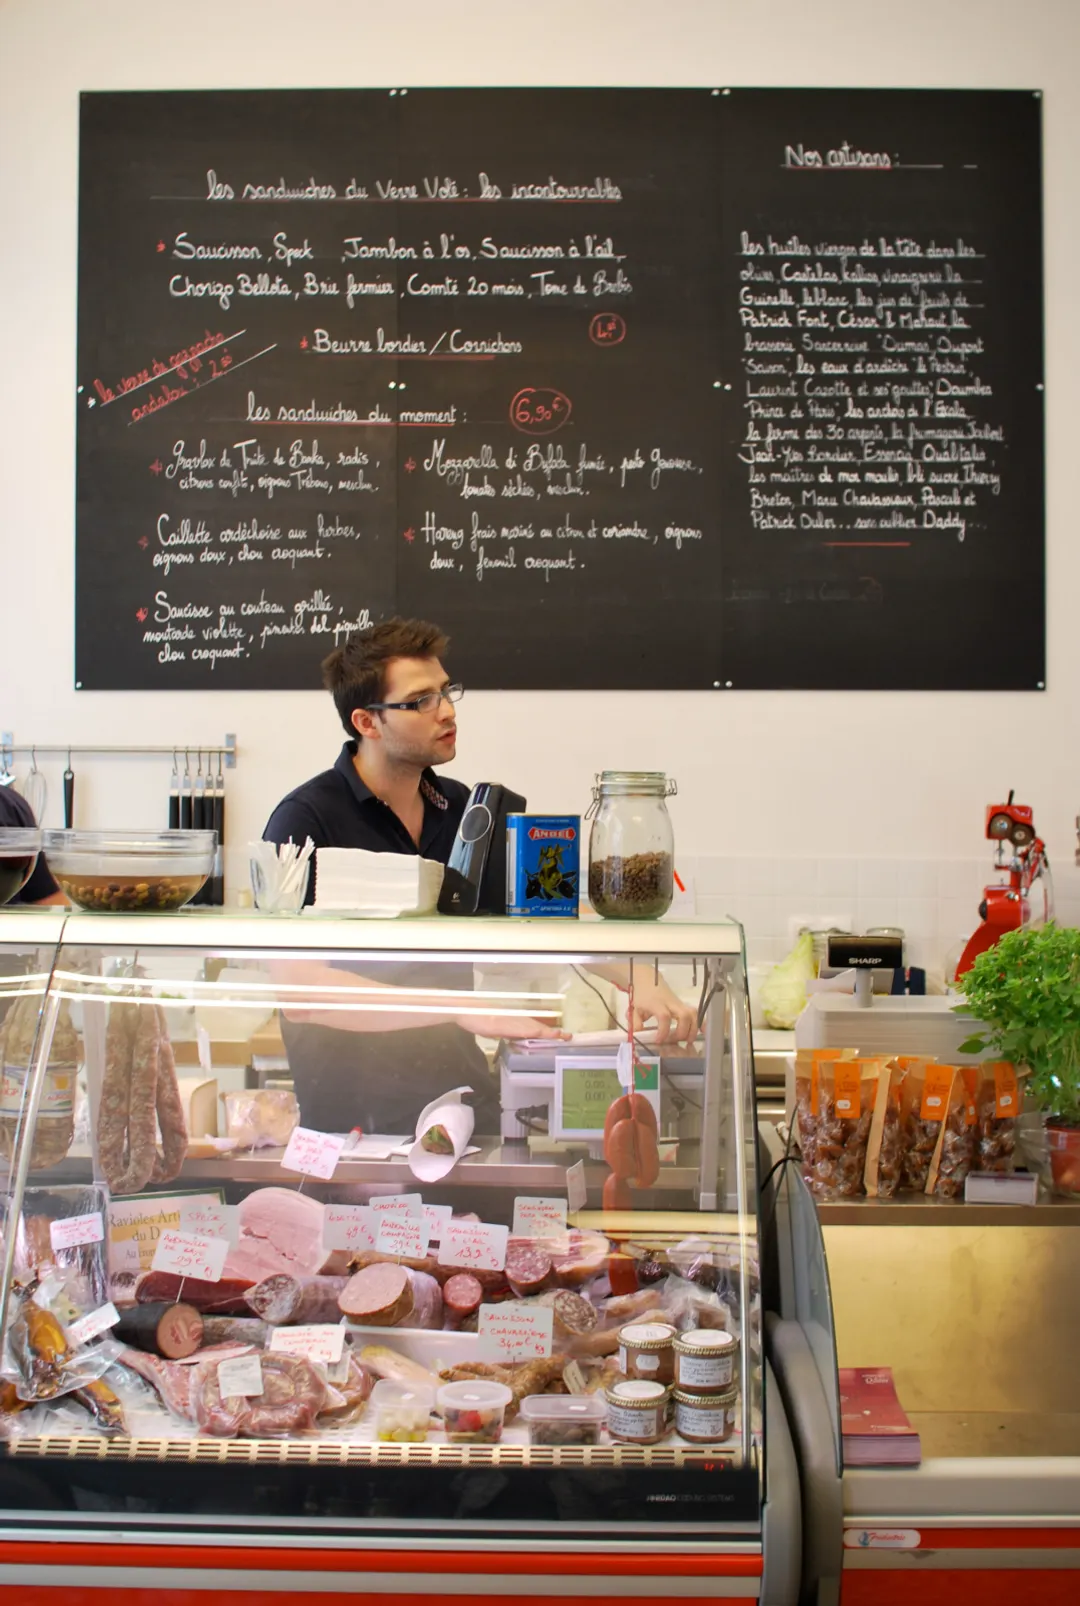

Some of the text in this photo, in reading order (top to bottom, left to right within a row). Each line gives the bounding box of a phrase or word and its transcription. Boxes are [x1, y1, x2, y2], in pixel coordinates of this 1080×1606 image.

[784, 144, 822, 167] Nos
[206, 169, 235, 200] les
[242, 177, 336, 200] sandwiches
[345, 178, 368, 199] du
[376, 178, 418, 199] Verre
[478, 172, 501, 200] les
[510, 175, 622, 200] incontournables
[479, 237, 564, 259] Saucisson
[169, 274, 234, 310] Chorizo
[406, 273, 459, 296] Comté
[467, 276, 488, 296] 20
[313, 328, 372, 352] Beurre
[247, 391, 457, 423] les sandwiches du moment
[154, 590, 213, 623] Saucisse
[848, 957, 882, 965] SHARP
